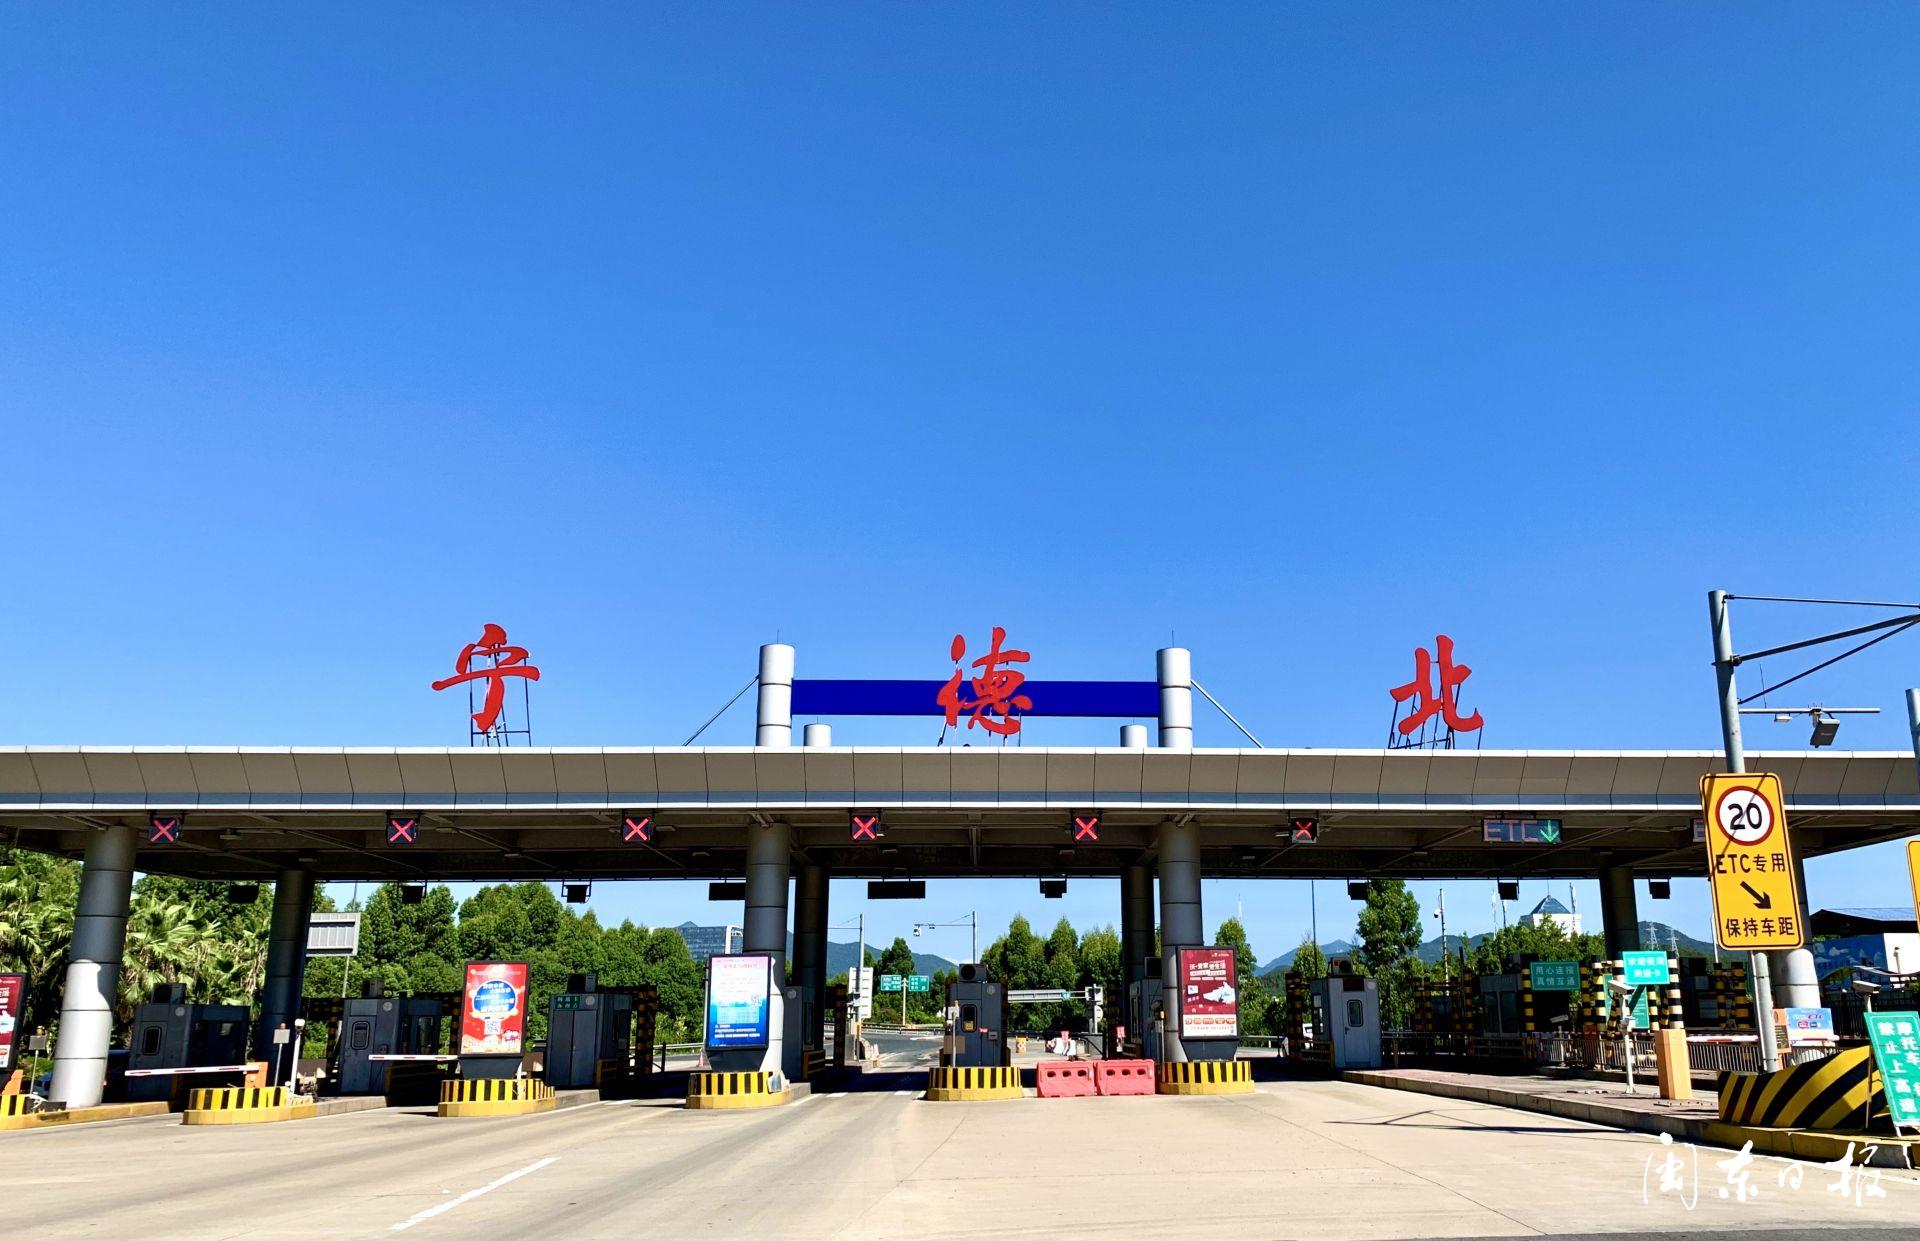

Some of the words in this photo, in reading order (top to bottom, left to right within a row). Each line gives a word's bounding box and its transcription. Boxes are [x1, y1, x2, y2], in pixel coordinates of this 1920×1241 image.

[1728, 803, 1763, 830] 20
[1483, 819, 1539, 842] ETC
[1716, 853, 1786, 874] ETC专用
[1726, 917, 1795, 938] 保持车距
[1535, 966, 1575, 975] 用心连接
[1537, 976, 1576, 986] 真情互通
[1877, 1021, 1918, 1113] 禁止上高速
